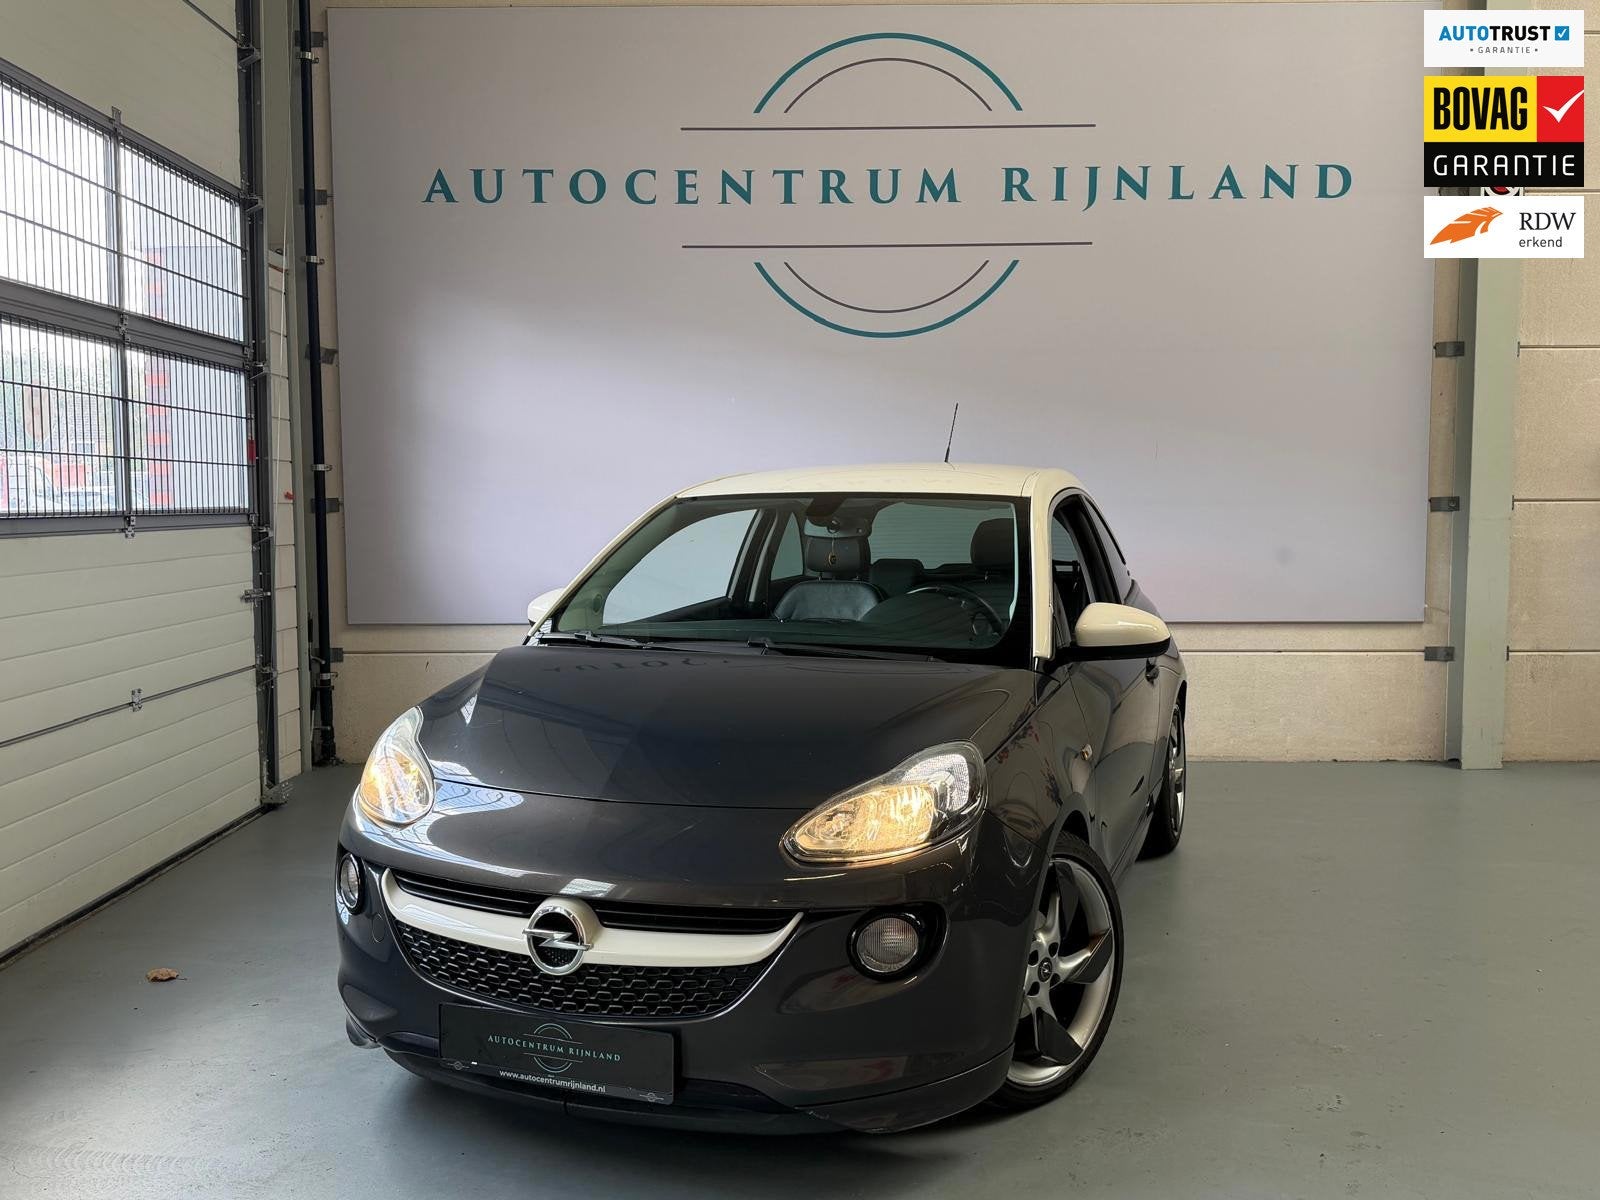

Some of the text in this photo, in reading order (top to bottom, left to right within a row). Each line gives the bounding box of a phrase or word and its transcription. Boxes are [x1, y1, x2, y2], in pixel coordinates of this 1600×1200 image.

[421, 163, 1353, 212] AUTOCENTRUM RIJNLAND
[487, 1035, 621, 1062] AUTOCENTRUM RIJNLAND
[499, 1069, 606, 1093] www.autocentrumrijnland.nl
